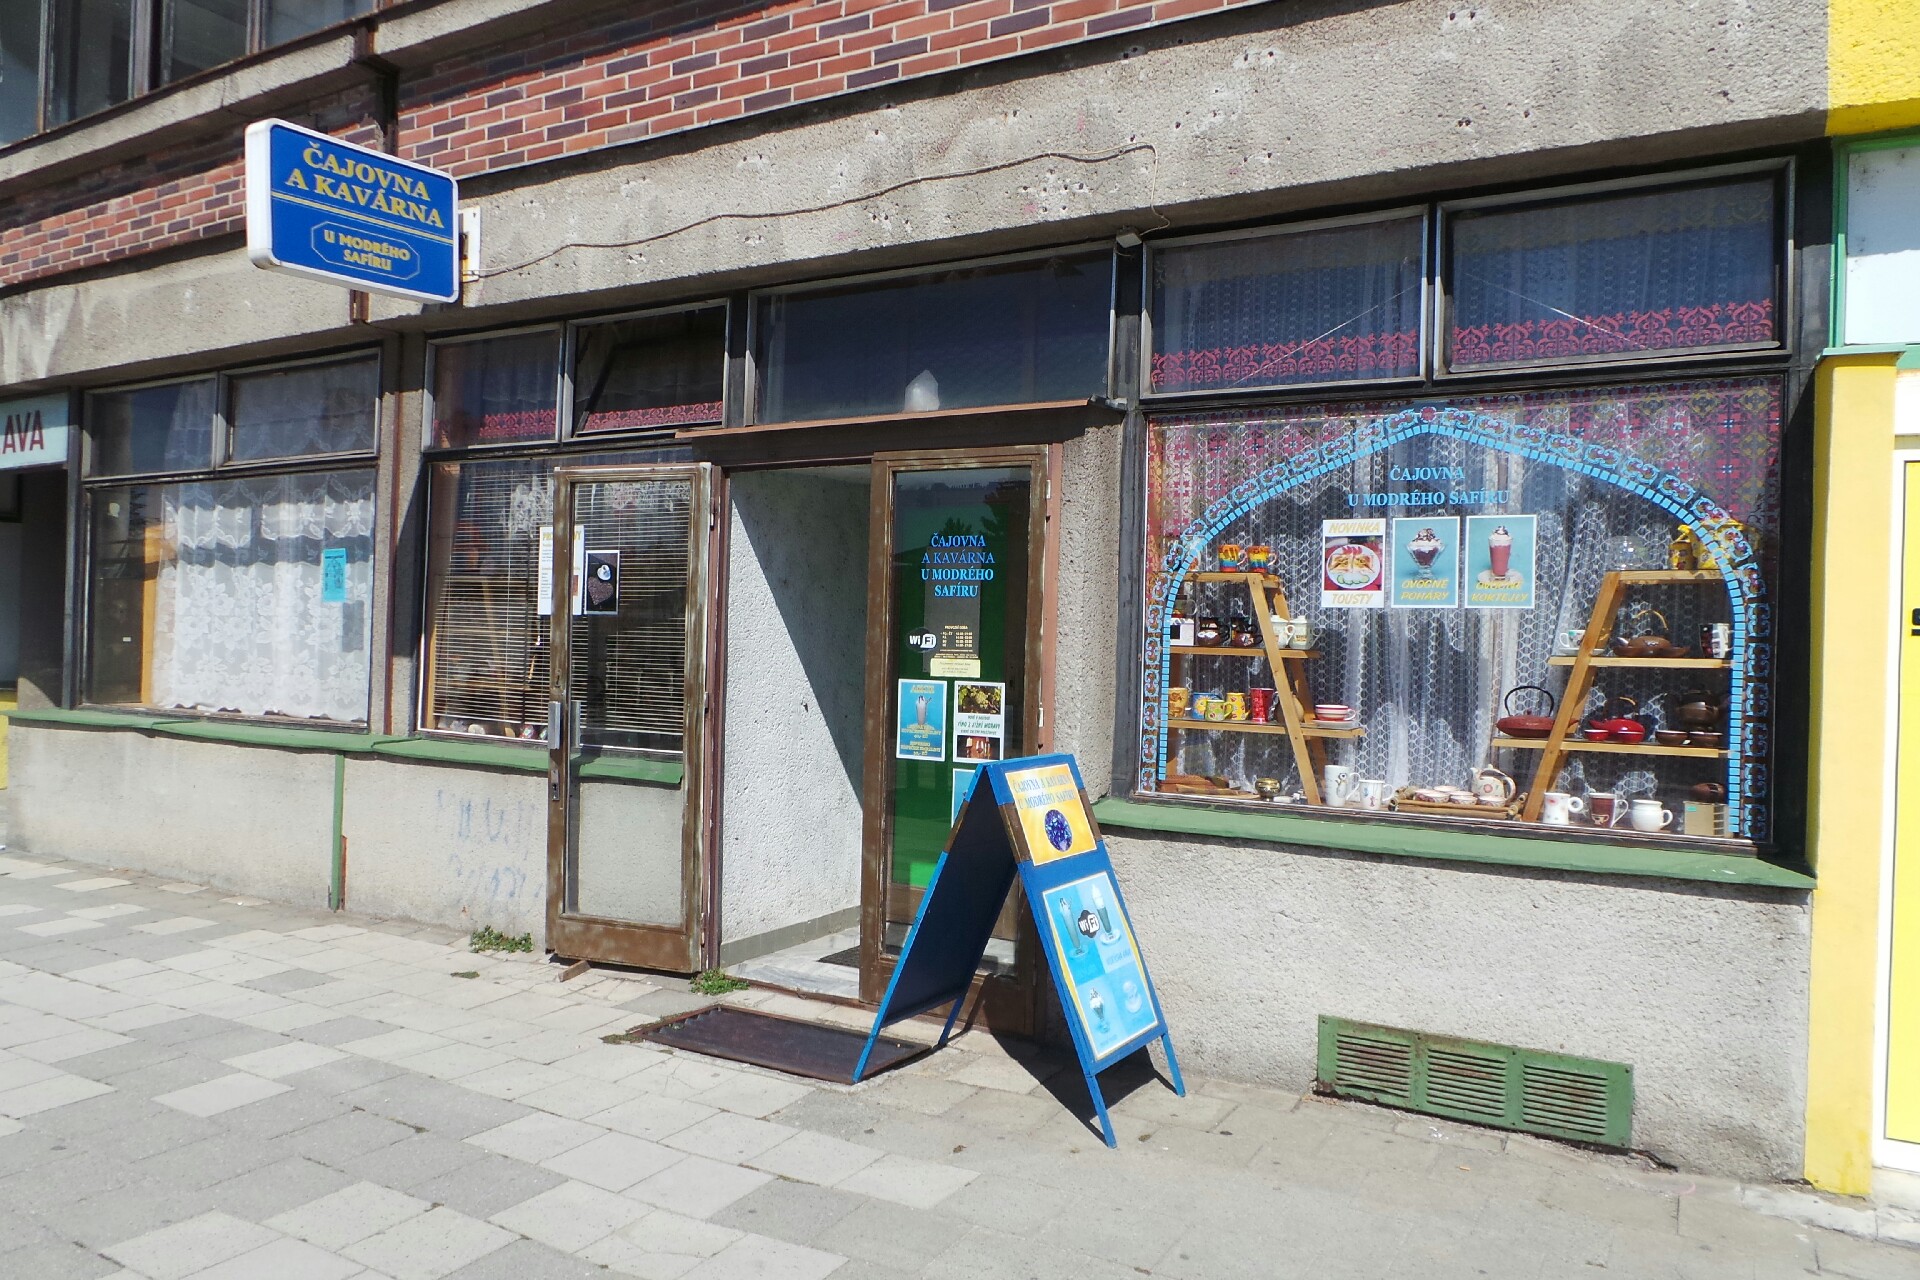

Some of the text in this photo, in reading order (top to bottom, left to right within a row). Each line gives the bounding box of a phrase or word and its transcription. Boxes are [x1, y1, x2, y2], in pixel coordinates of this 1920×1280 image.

[303, 141, 430, 201] ČAJOVNA
[285, 169, 445, 228] A KAVÁRNA
[324, 229, 411, 261] U MODRÉHO
[343, 249, 392, 271] SAFÍRU
[1389, 465, 1465, 481] ČAJOVNA
[1347, 487, 1511, 507] U MODRÉHO SAFÍRU
[1329, 522, 1380, 534] NOVINKA
[931, 532, 986, 547] ČAJOVNA
[921, 548, 995, 564] A KAVÁRNA
[921, 565, 994, 580] U MODRÉHO
[934, 581, 978, 597] SAFÍRU
[1332, 594, 1373, 605] TOUSTY
